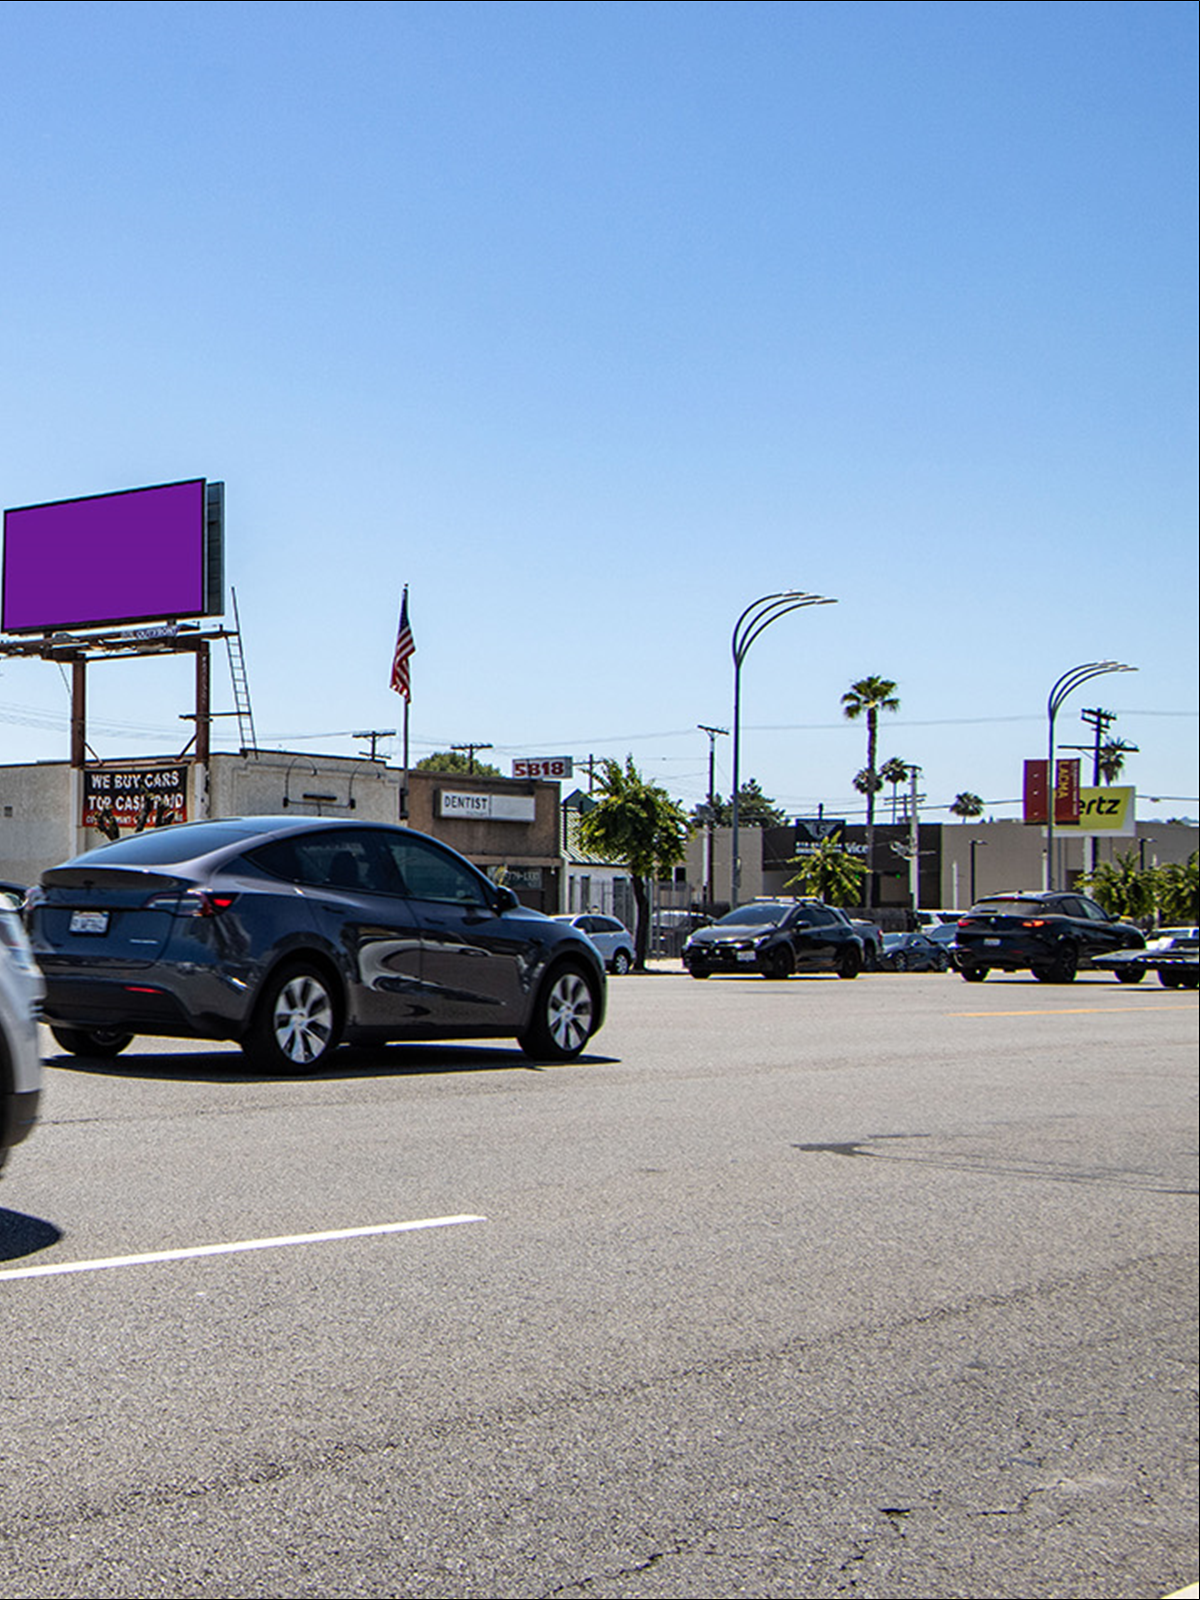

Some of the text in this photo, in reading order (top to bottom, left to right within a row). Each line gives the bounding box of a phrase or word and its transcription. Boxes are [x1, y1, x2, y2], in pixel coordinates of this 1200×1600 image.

[514, 761, 564, 778] 5818
[91, 770, 179, 789] WE BUY CARS
[1058, 761, 1069, 799] LACMA
[88, 795, 111, 811] TOP
[444, 795, 488, 810] DENTIST
[1079, 796, 1121, 815] ertz
